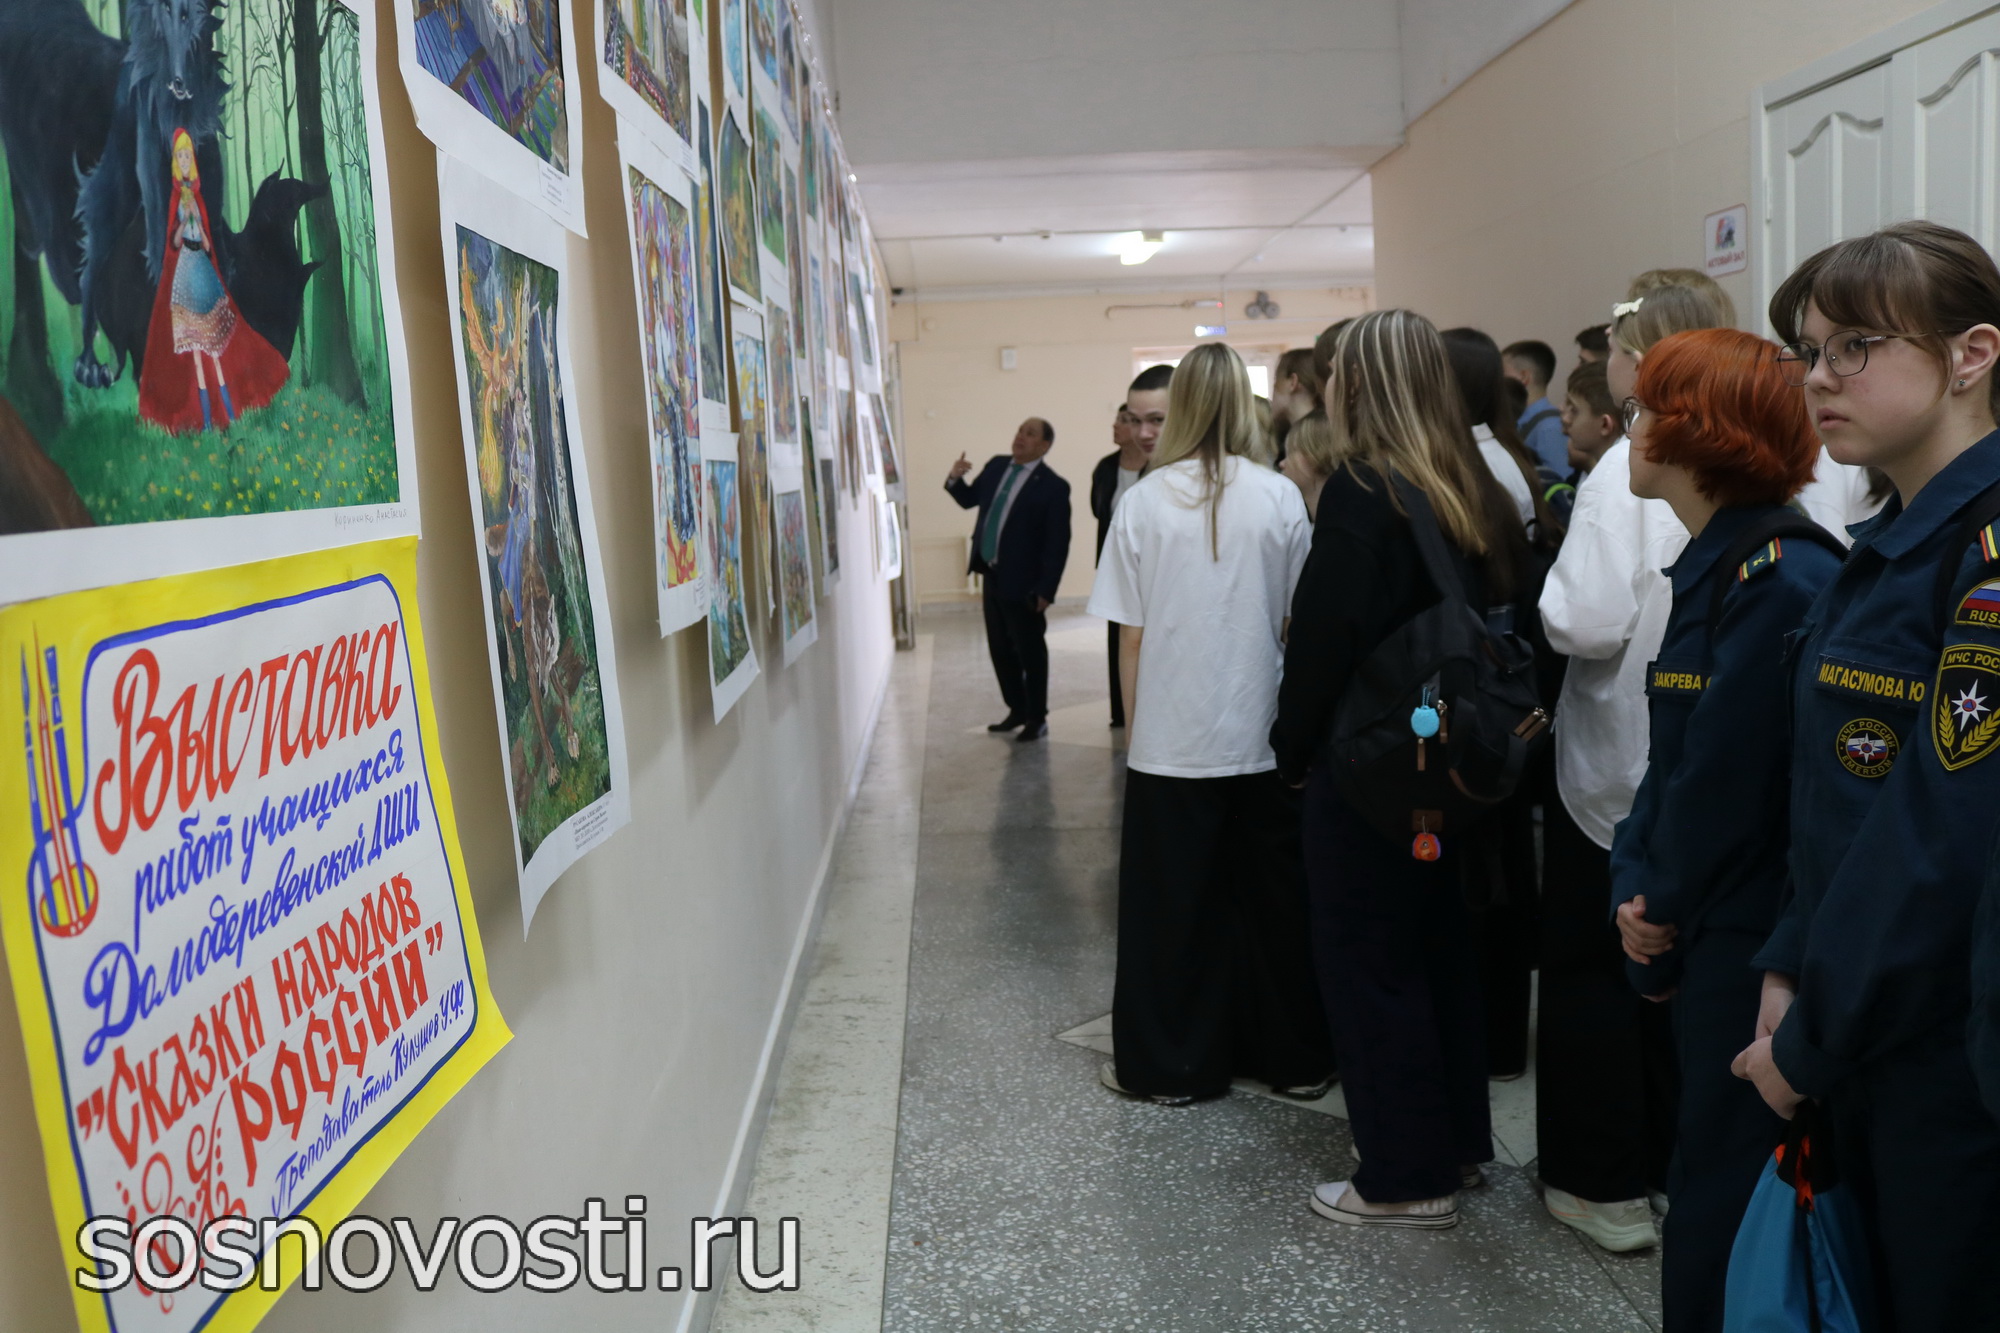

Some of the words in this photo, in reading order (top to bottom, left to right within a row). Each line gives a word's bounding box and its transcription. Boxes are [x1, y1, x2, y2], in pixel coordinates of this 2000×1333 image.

[1969, 609, 2000, 624] RUS
[1946, 652, 1971, 664] МЧС
[1974, 653, 2000, 669] РОС
[1654, 672, 1702, 691] ЗАКРЕВА
[1818, 663, 1904, 699] МАГАСУМОВА
[1908, 681, 1926, 702] Ю
[94, 620, 402, 855] Выставка
[1840, 724, 1856, 743] МЧС
[1841, 755, 1893, 775] EMERCOM
[133, 810, 233, 955] работ
[241, 728, 405, 884] учащихся
[271, 1075, 392, 1217] Преподаватель
